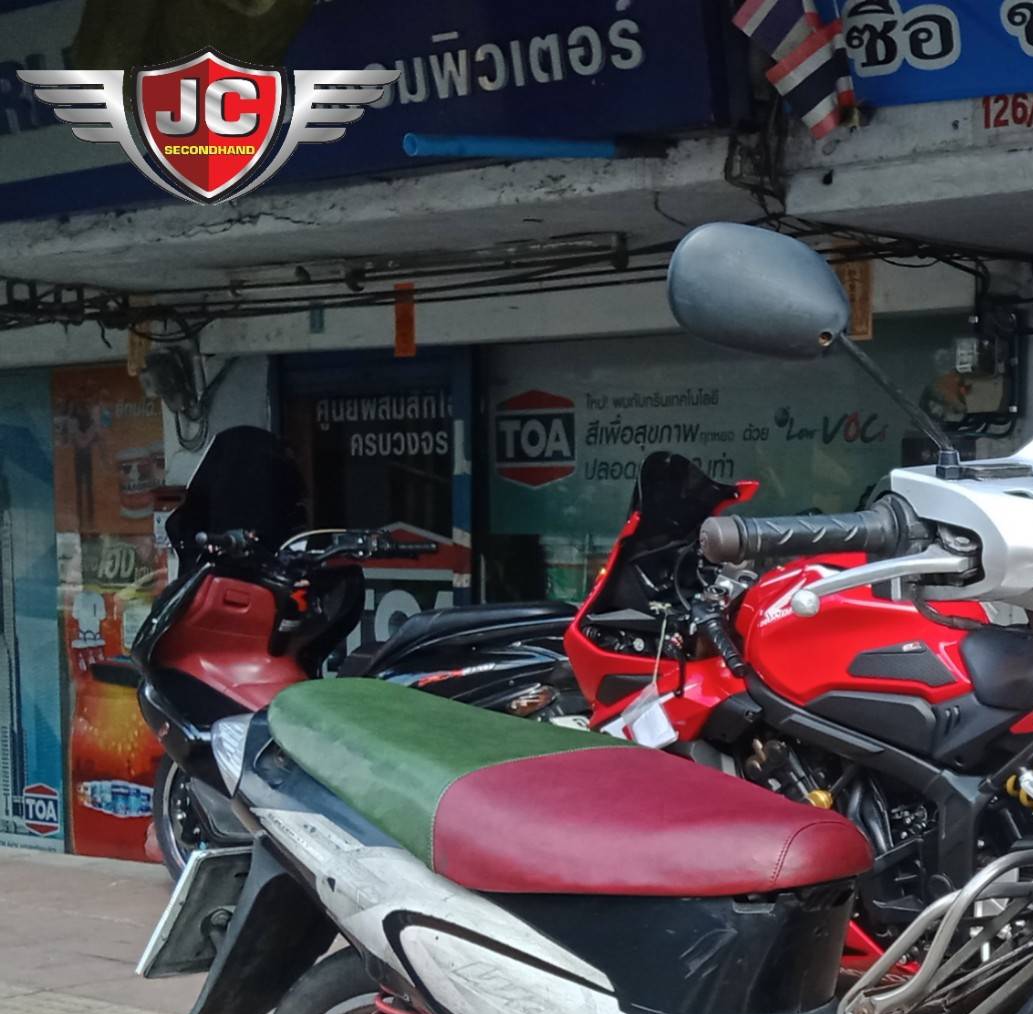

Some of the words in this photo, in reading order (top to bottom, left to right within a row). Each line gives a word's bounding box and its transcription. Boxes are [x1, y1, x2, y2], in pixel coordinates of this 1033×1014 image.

[846, 0, 954, 68] ซือ
[362, 0, 645, 110] มพิวเตอร์
[350, 430, 449, 457] ครบวงจร
[497, 418, 573, 459] TOA
[707, 452, 735, 479] เท่า
[26, 798, 58, 823] TOA
